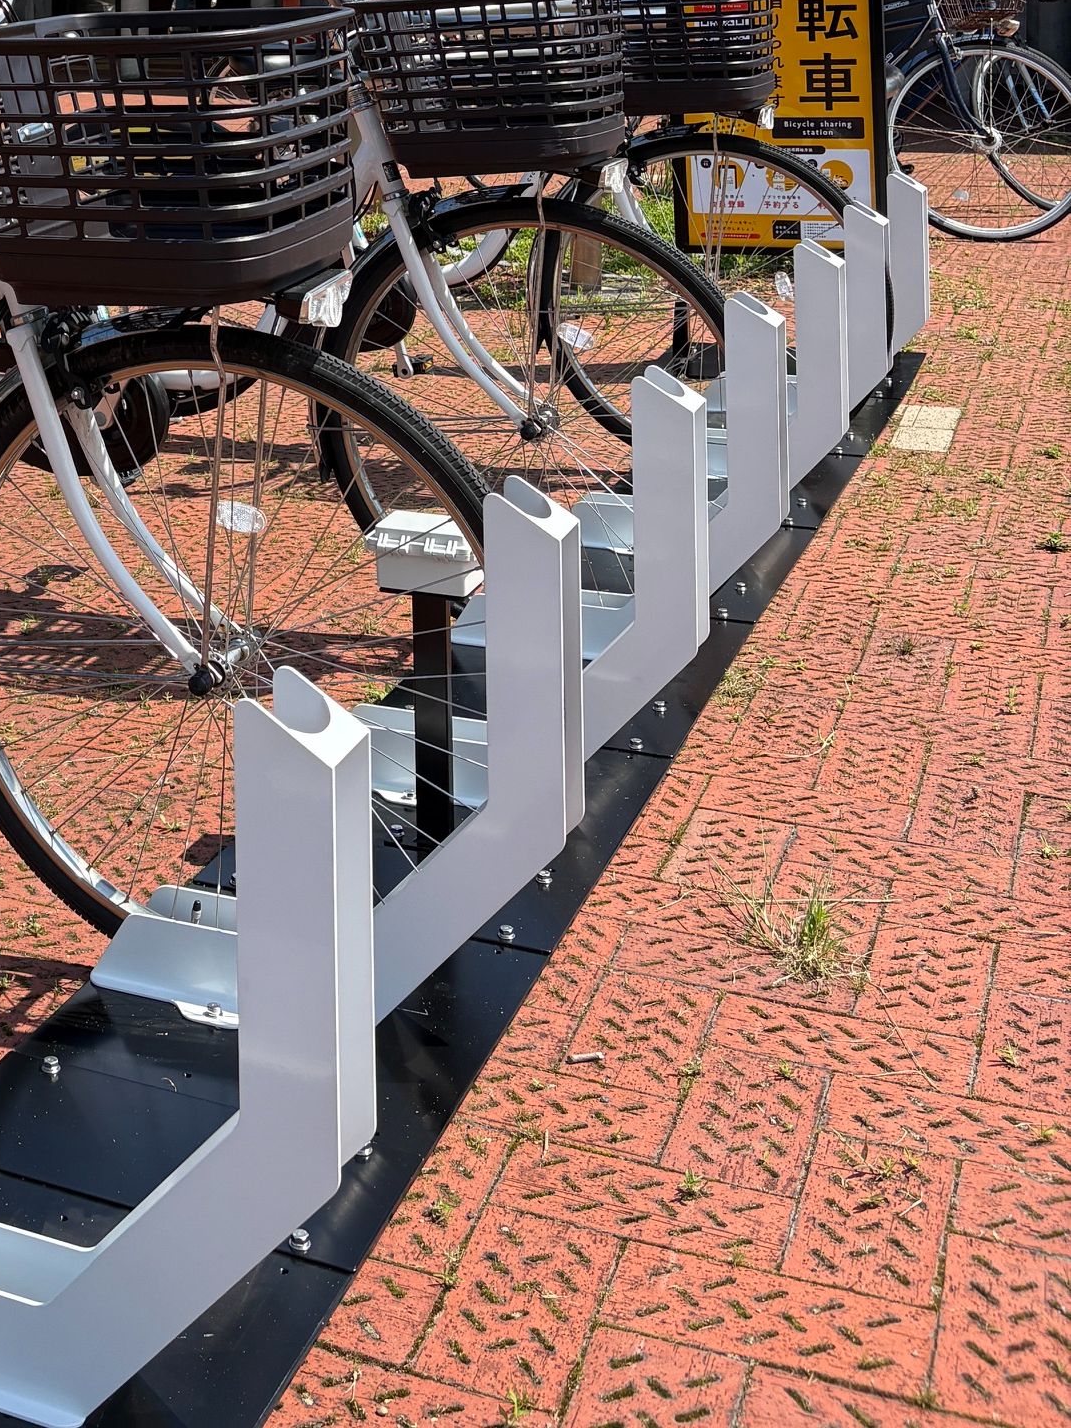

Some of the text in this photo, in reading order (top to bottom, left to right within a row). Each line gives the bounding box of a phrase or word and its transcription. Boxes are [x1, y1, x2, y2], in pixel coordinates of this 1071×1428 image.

[783, 120, 853, 130] Bicycle sharing
[763, 200, 800, 209] 予約する
